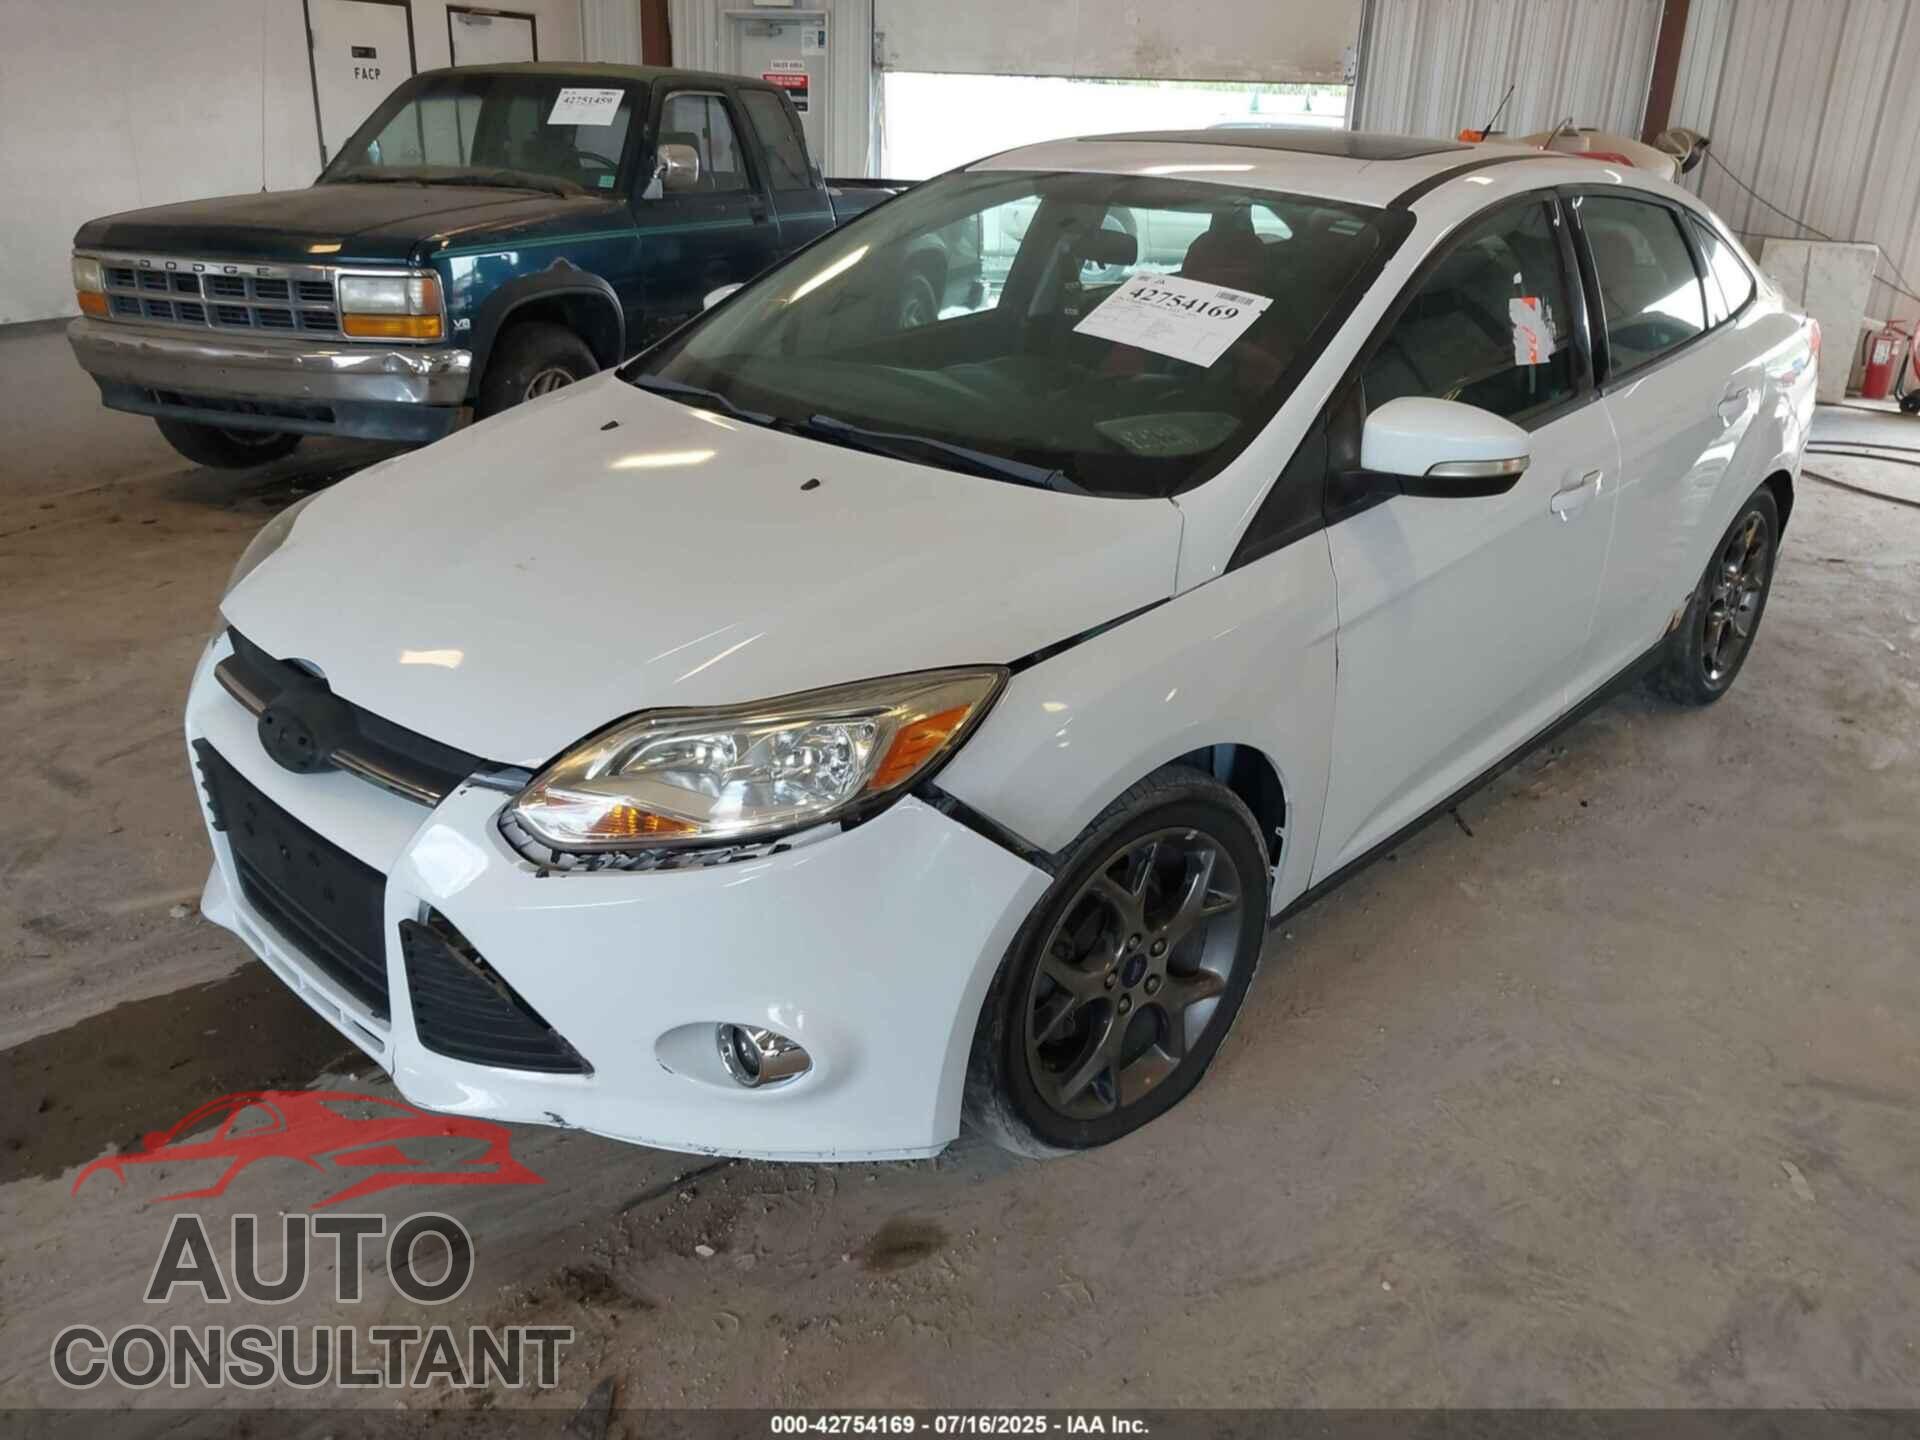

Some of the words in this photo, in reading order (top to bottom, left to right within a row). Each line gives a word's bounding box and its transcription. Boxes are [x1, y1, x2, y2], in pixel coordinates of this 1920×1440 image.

[354, 67, 381, 80] FACP
[139, 259, 273, 277] DODGE
[1129, 286, 1240, 320] 42754169
